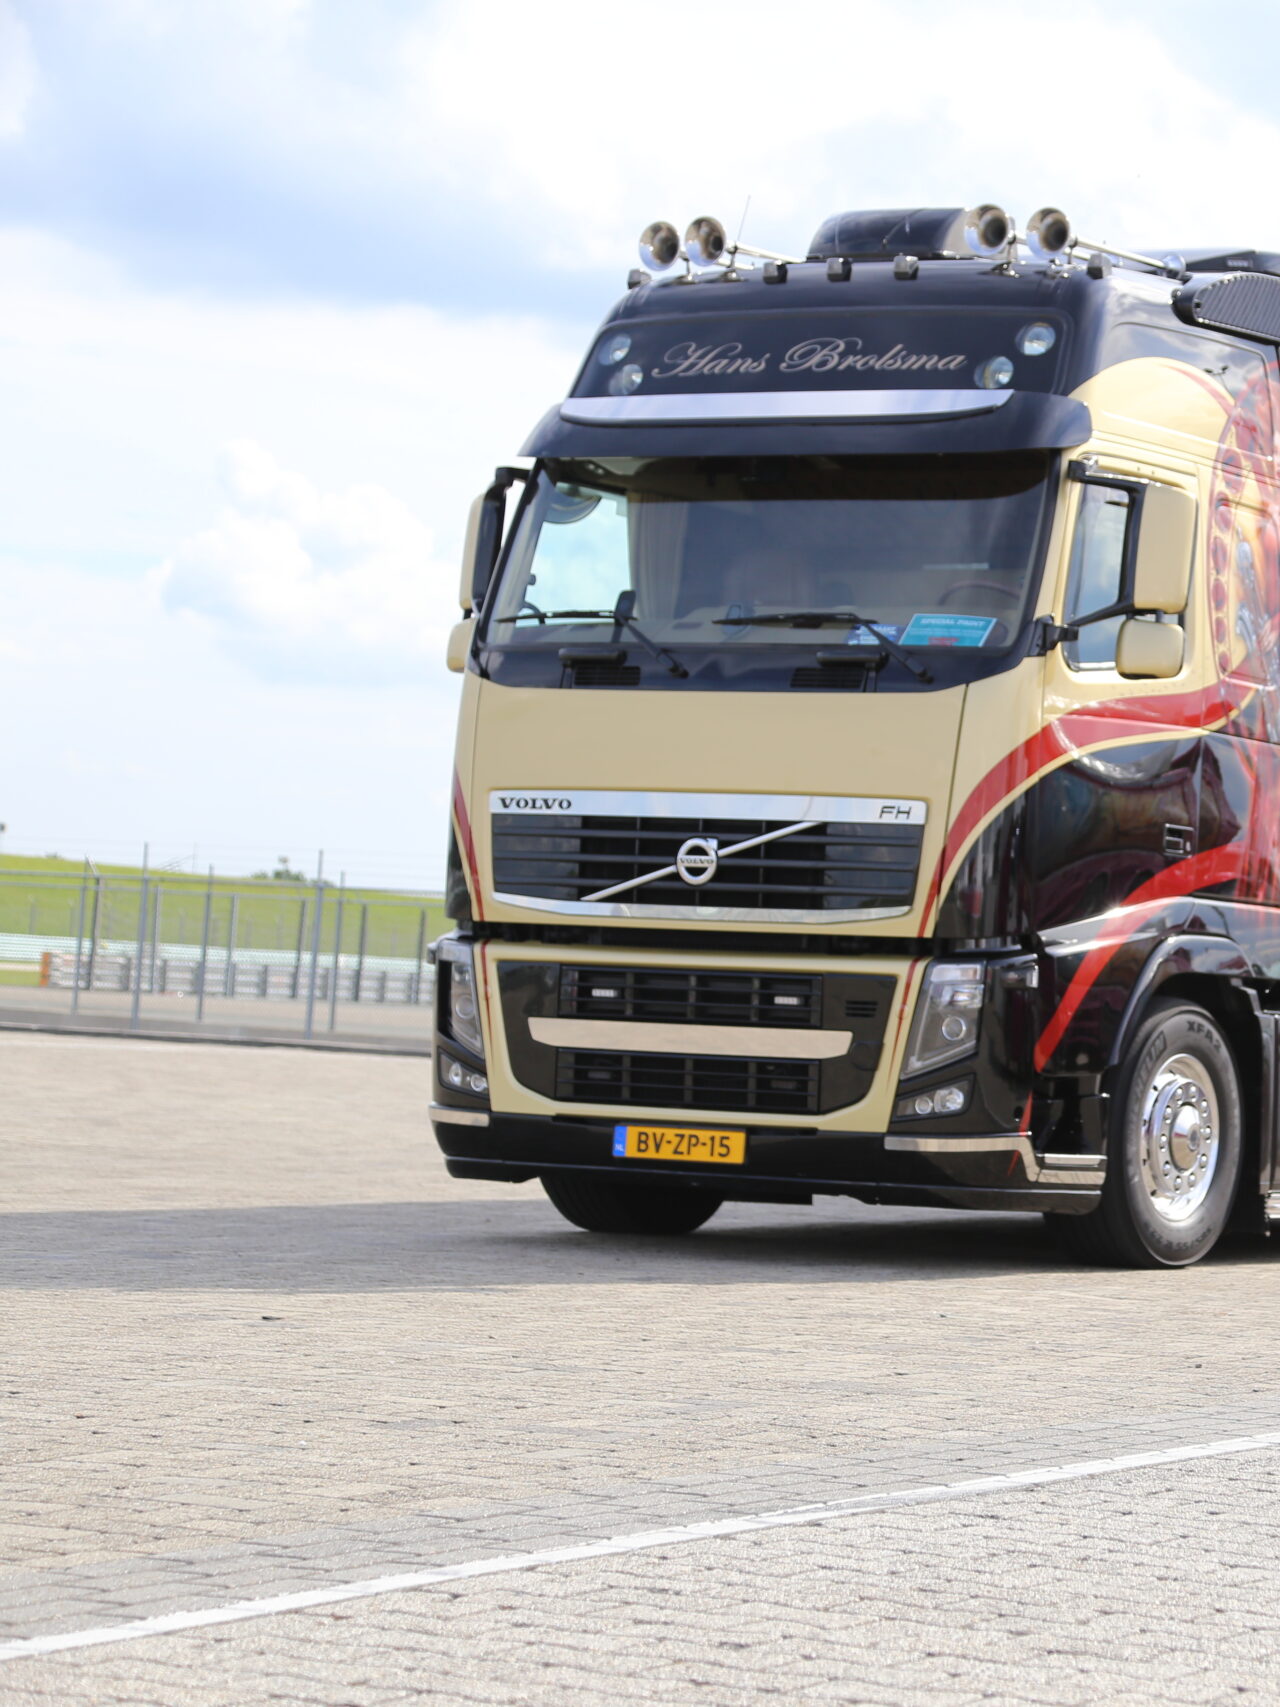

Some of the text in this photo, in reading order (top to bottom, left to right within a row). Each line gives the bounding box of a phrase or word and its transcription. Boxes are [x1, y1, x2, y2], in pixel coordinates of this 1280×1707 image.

[651, 337, 968, 379] Hans Brolsma
[498, 797, 572, 810] VOLVO
[879, 805, 912, 820] FH
[680, 857, 715, 865] VOLVO
[615, 1143, 625, 1152] NL
[636, 1131, 730, 1158] BV-ZP-15
